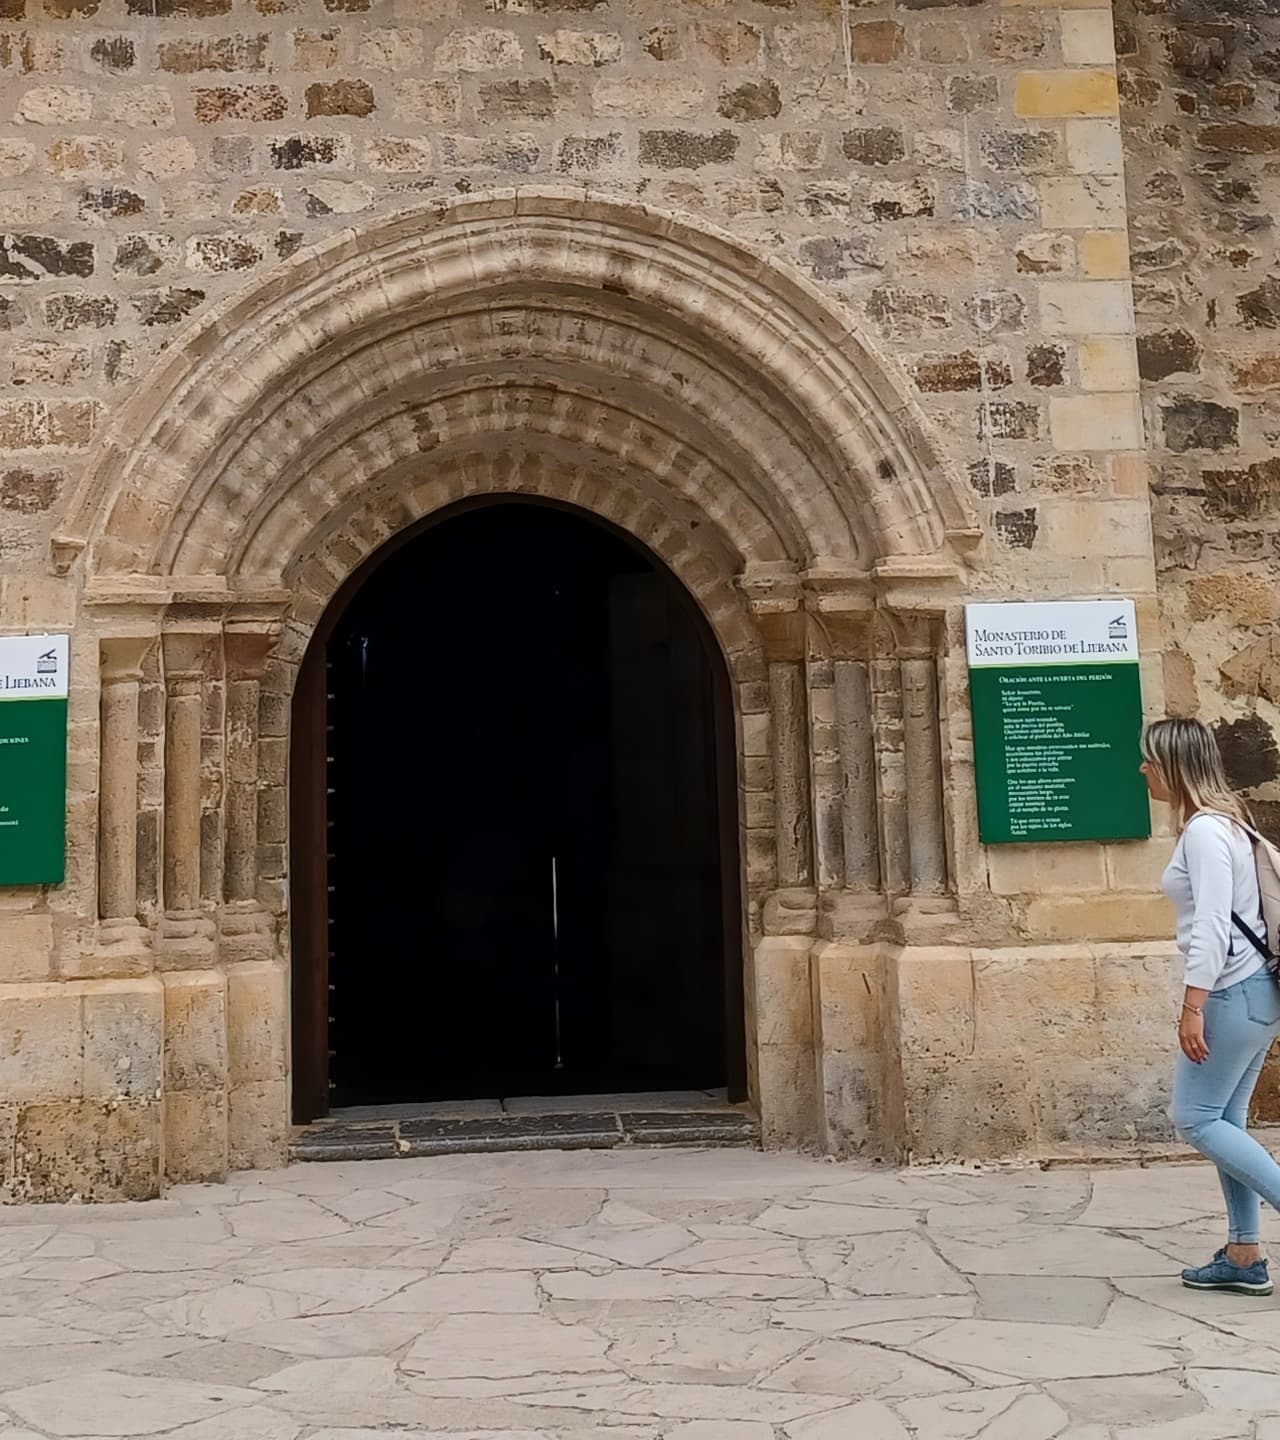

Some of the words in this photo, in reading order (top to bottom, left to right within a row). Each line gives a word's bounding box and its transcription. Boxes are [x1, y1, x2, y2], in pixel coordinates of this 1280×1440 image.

[974, 629, 1050, 643] MONASTERIO
[1051, 629, 1066, 640] DE
[975, 643, 1013, 657] SANTO
[1014, 642, 1061, 655] TORIBIO
[1063, 643, 1079, 654] DE
